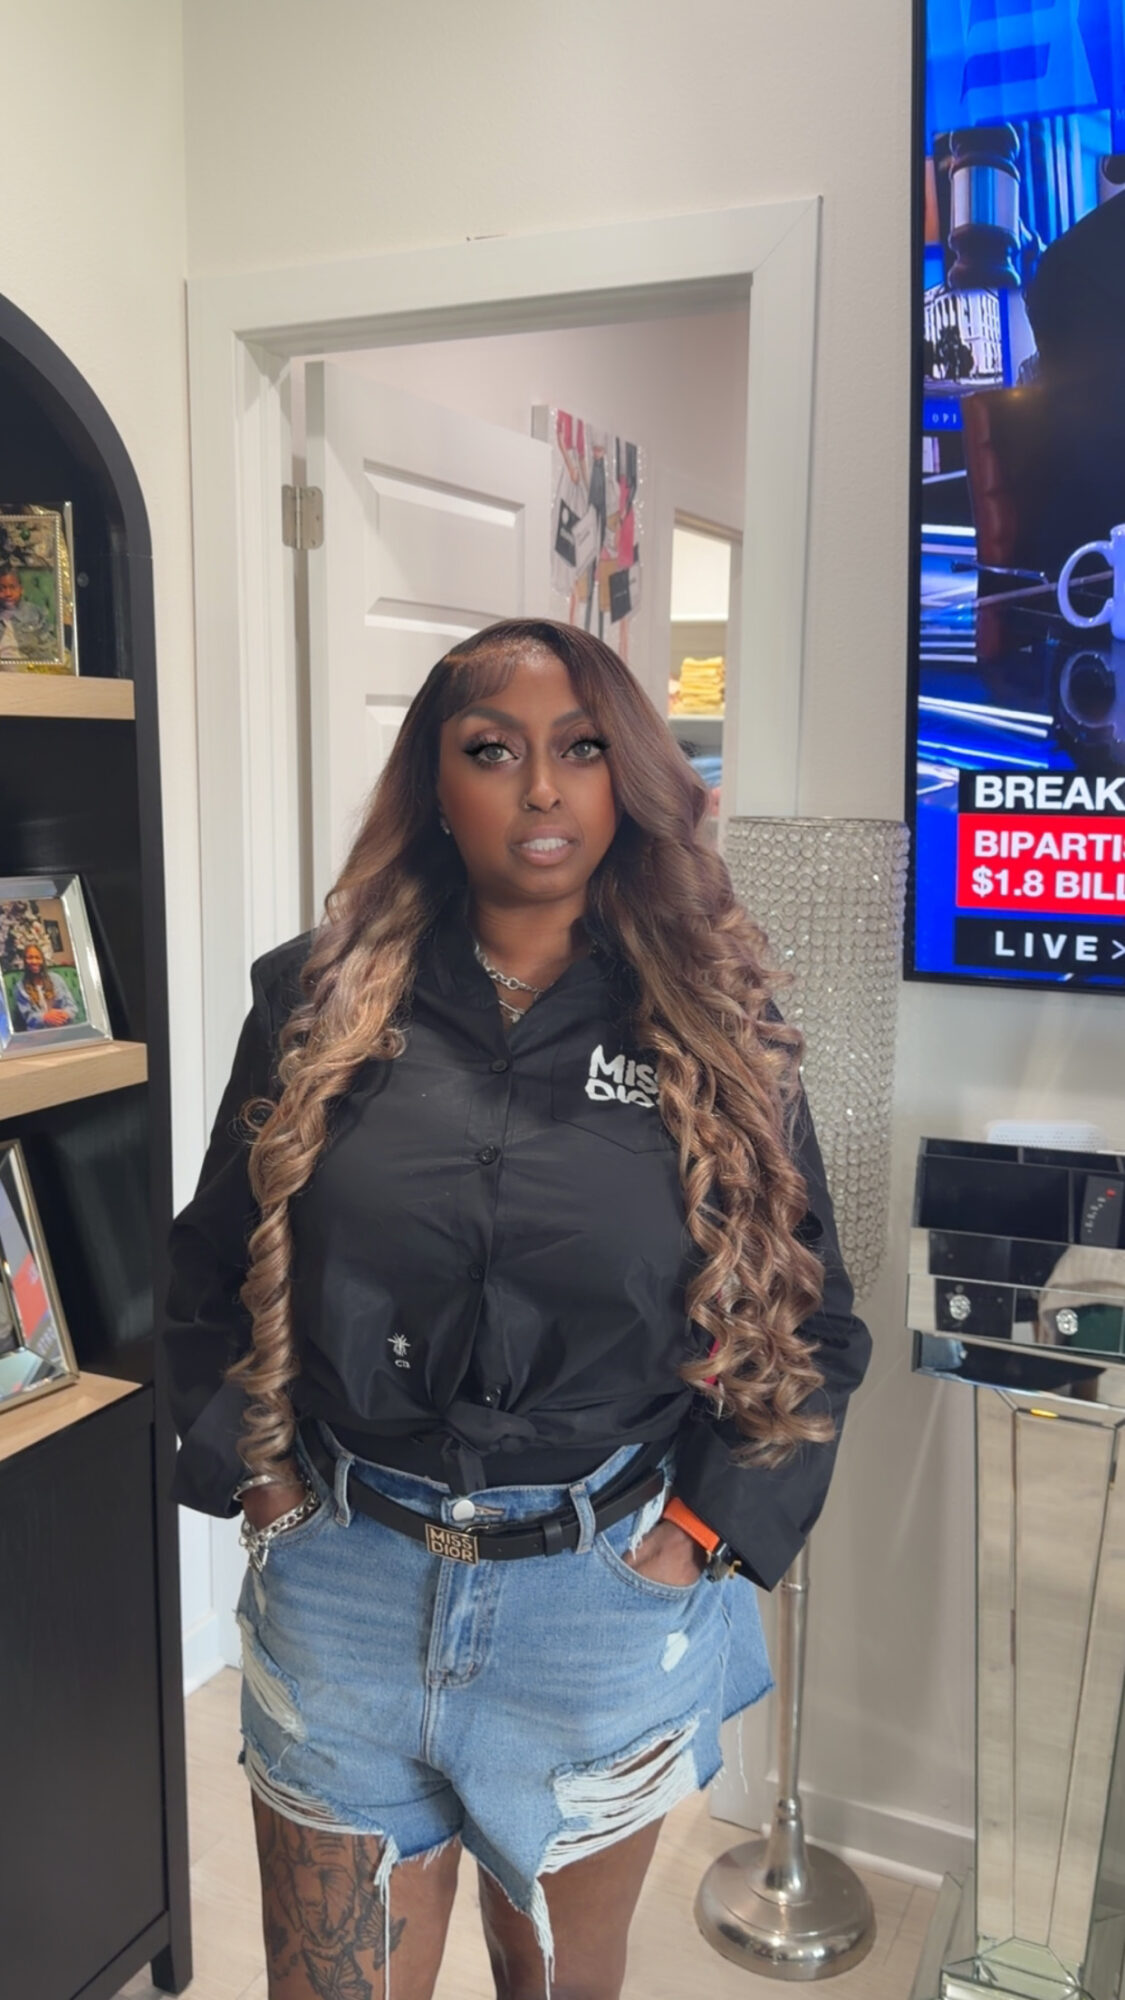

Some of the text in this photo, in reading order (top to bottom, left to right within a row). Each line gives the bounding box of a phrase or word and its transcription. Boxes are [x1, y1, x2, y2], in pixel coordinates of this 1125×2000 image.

[975, 775, 1125, 811] BREAK
[974, 830, 1125, 862] BIPARTI
[971, 864, 1044, 898] $1.8
[995, 930, 1098, 962] LIVE
[589, 1044, 659, 1094] MIS
[585, 1078, 660, 1108] DIO
[430, 1527, 473, 1550] MISS
[431, 1540, 474, 1562] DIOR
